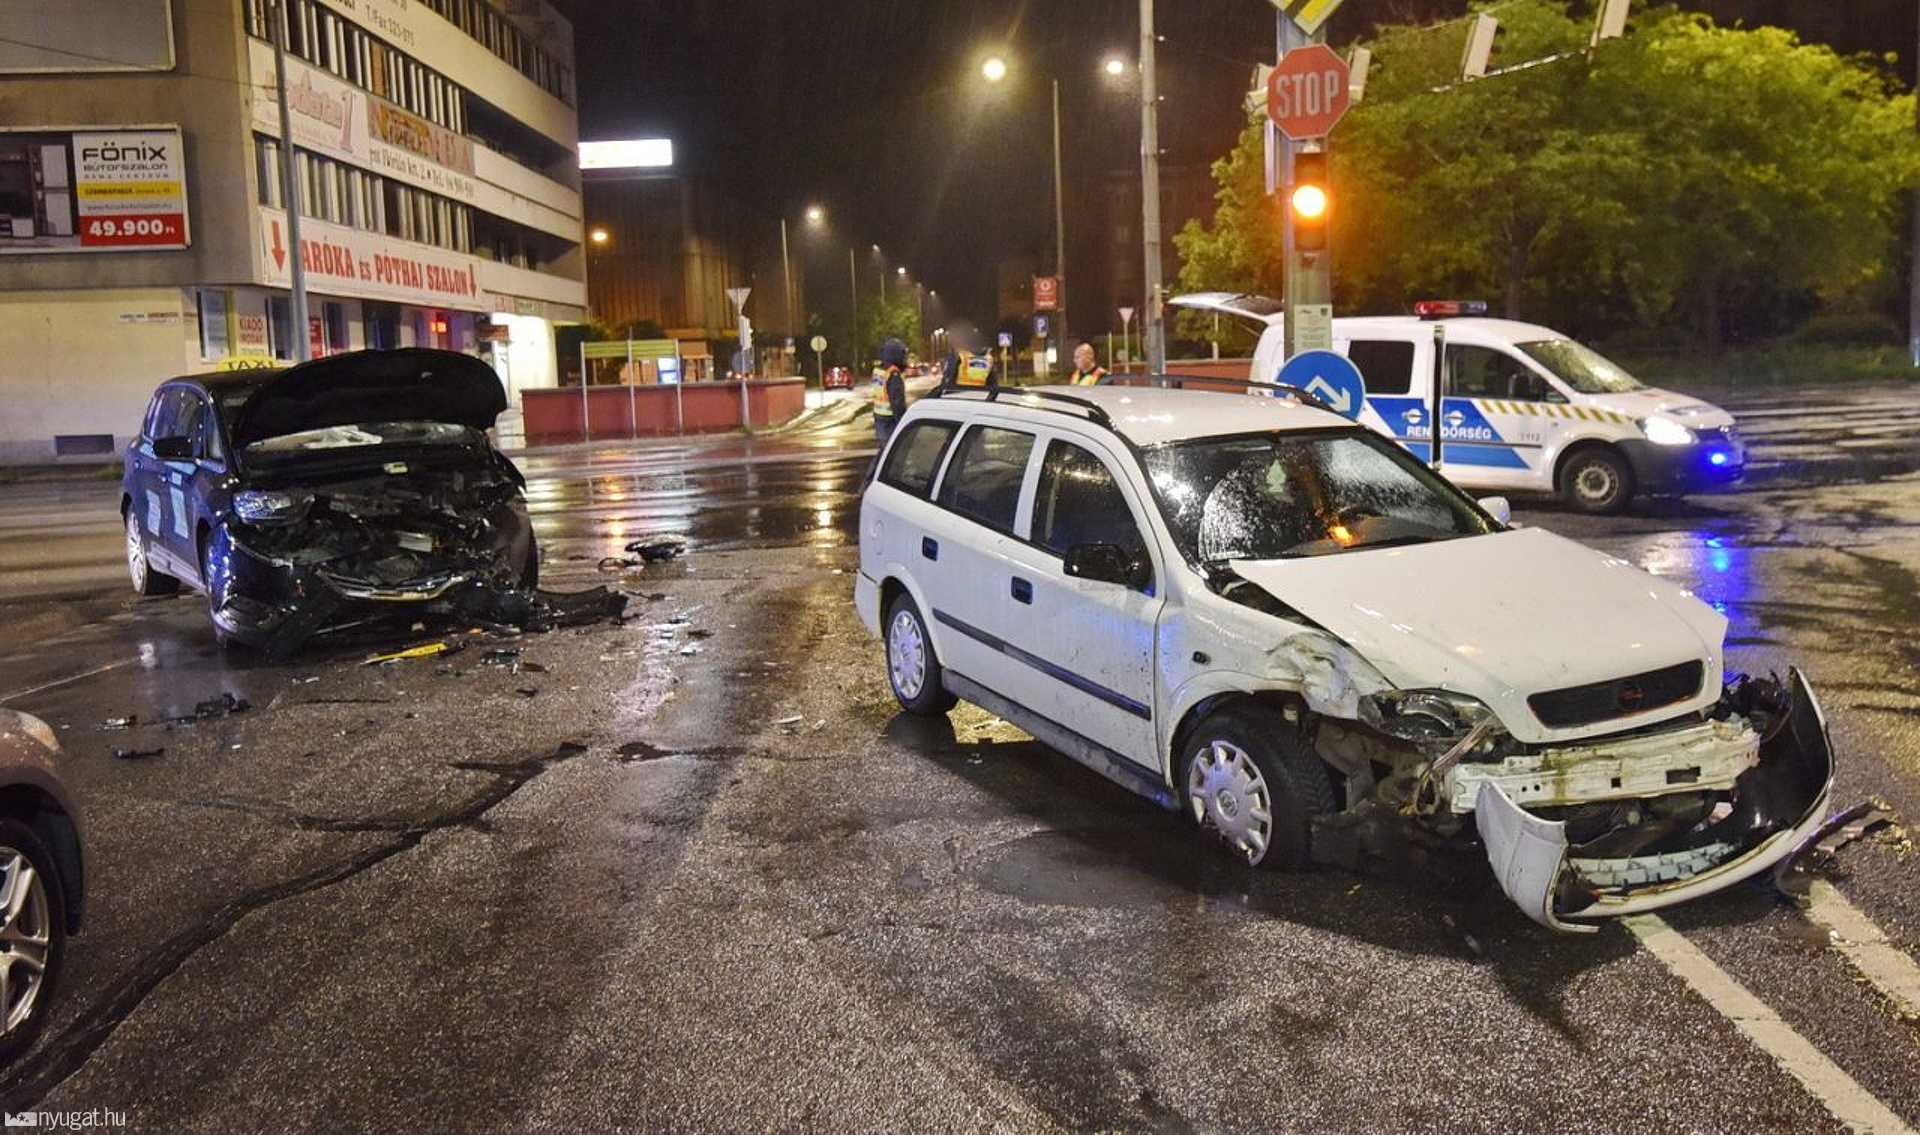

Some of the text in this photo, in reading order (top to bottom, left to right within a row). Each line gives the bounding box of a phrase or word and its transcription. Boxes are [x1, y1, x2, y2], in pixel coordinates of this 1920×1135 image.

[1276, 69, 1340, 119] STOP
[89, 219, 164, 236] 49.900
[301, 235, 355, 279] ARÓKA
[426, 263, 469, 297] SZALON
[226, 359, 275, 371] TAXI
